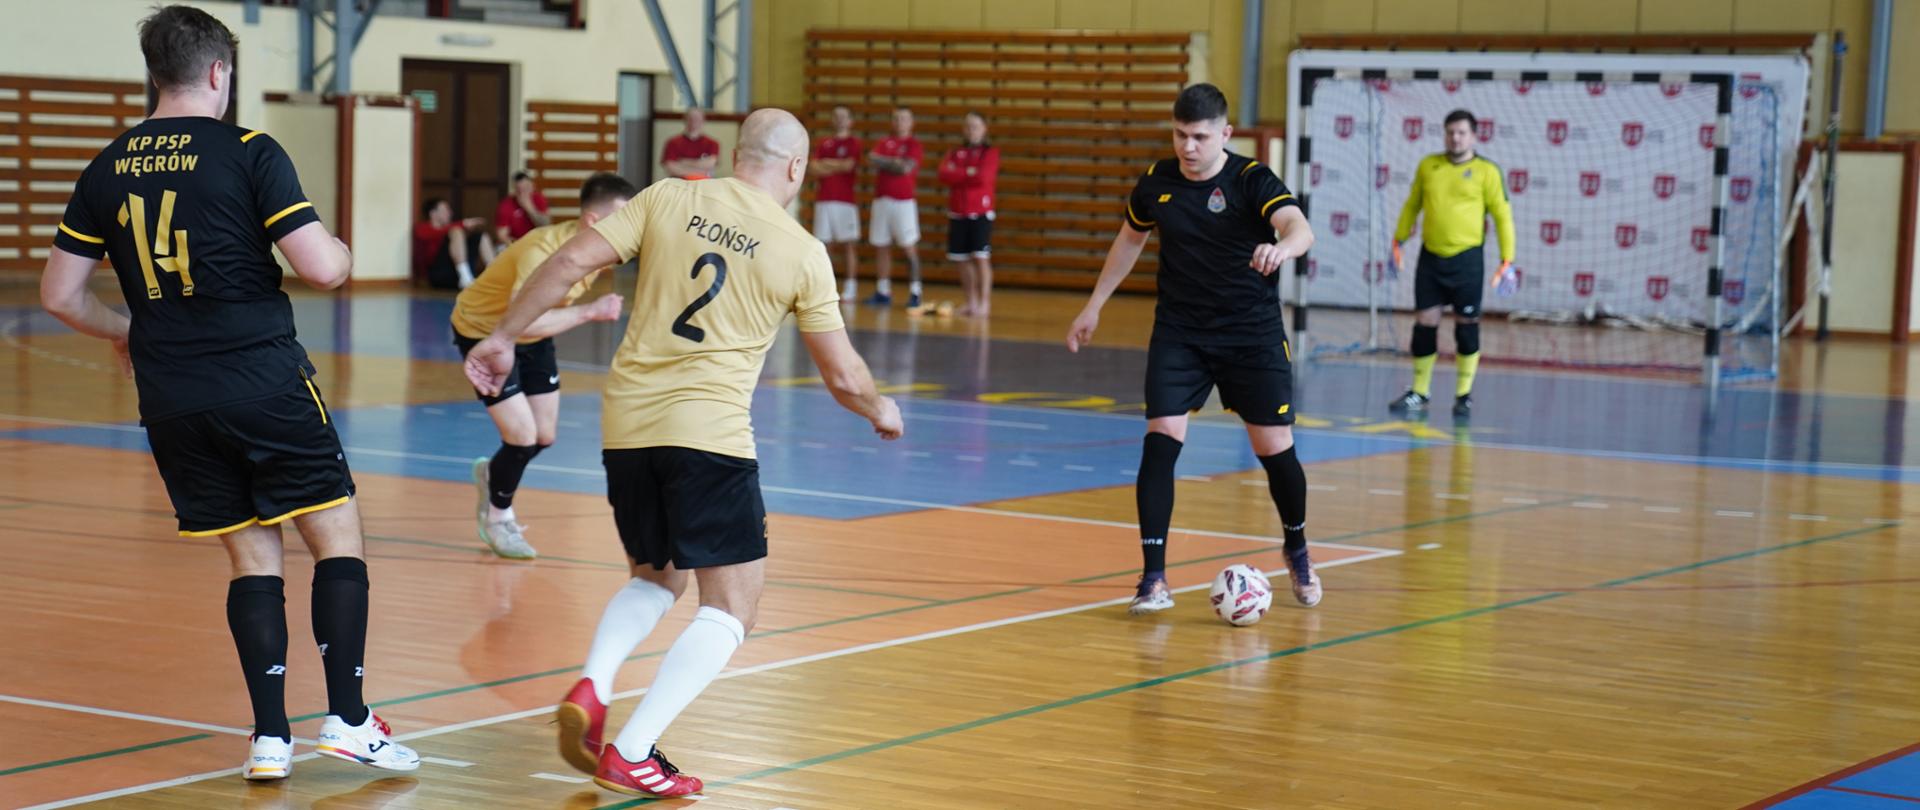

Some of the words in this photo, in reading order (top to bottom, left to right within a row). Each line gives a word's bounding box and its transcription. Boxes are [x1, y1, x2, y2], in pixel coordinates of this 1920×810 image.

[115, 151, 199, 177] WĘGRÓW
[127, 135, 152, 152] KP
[154, 133, 192, 150] PSP
[117, 189, 195, 300] 14
[685, 215, 761, 259] PŁOŃSK
[671, 252, 728, 343] 2
